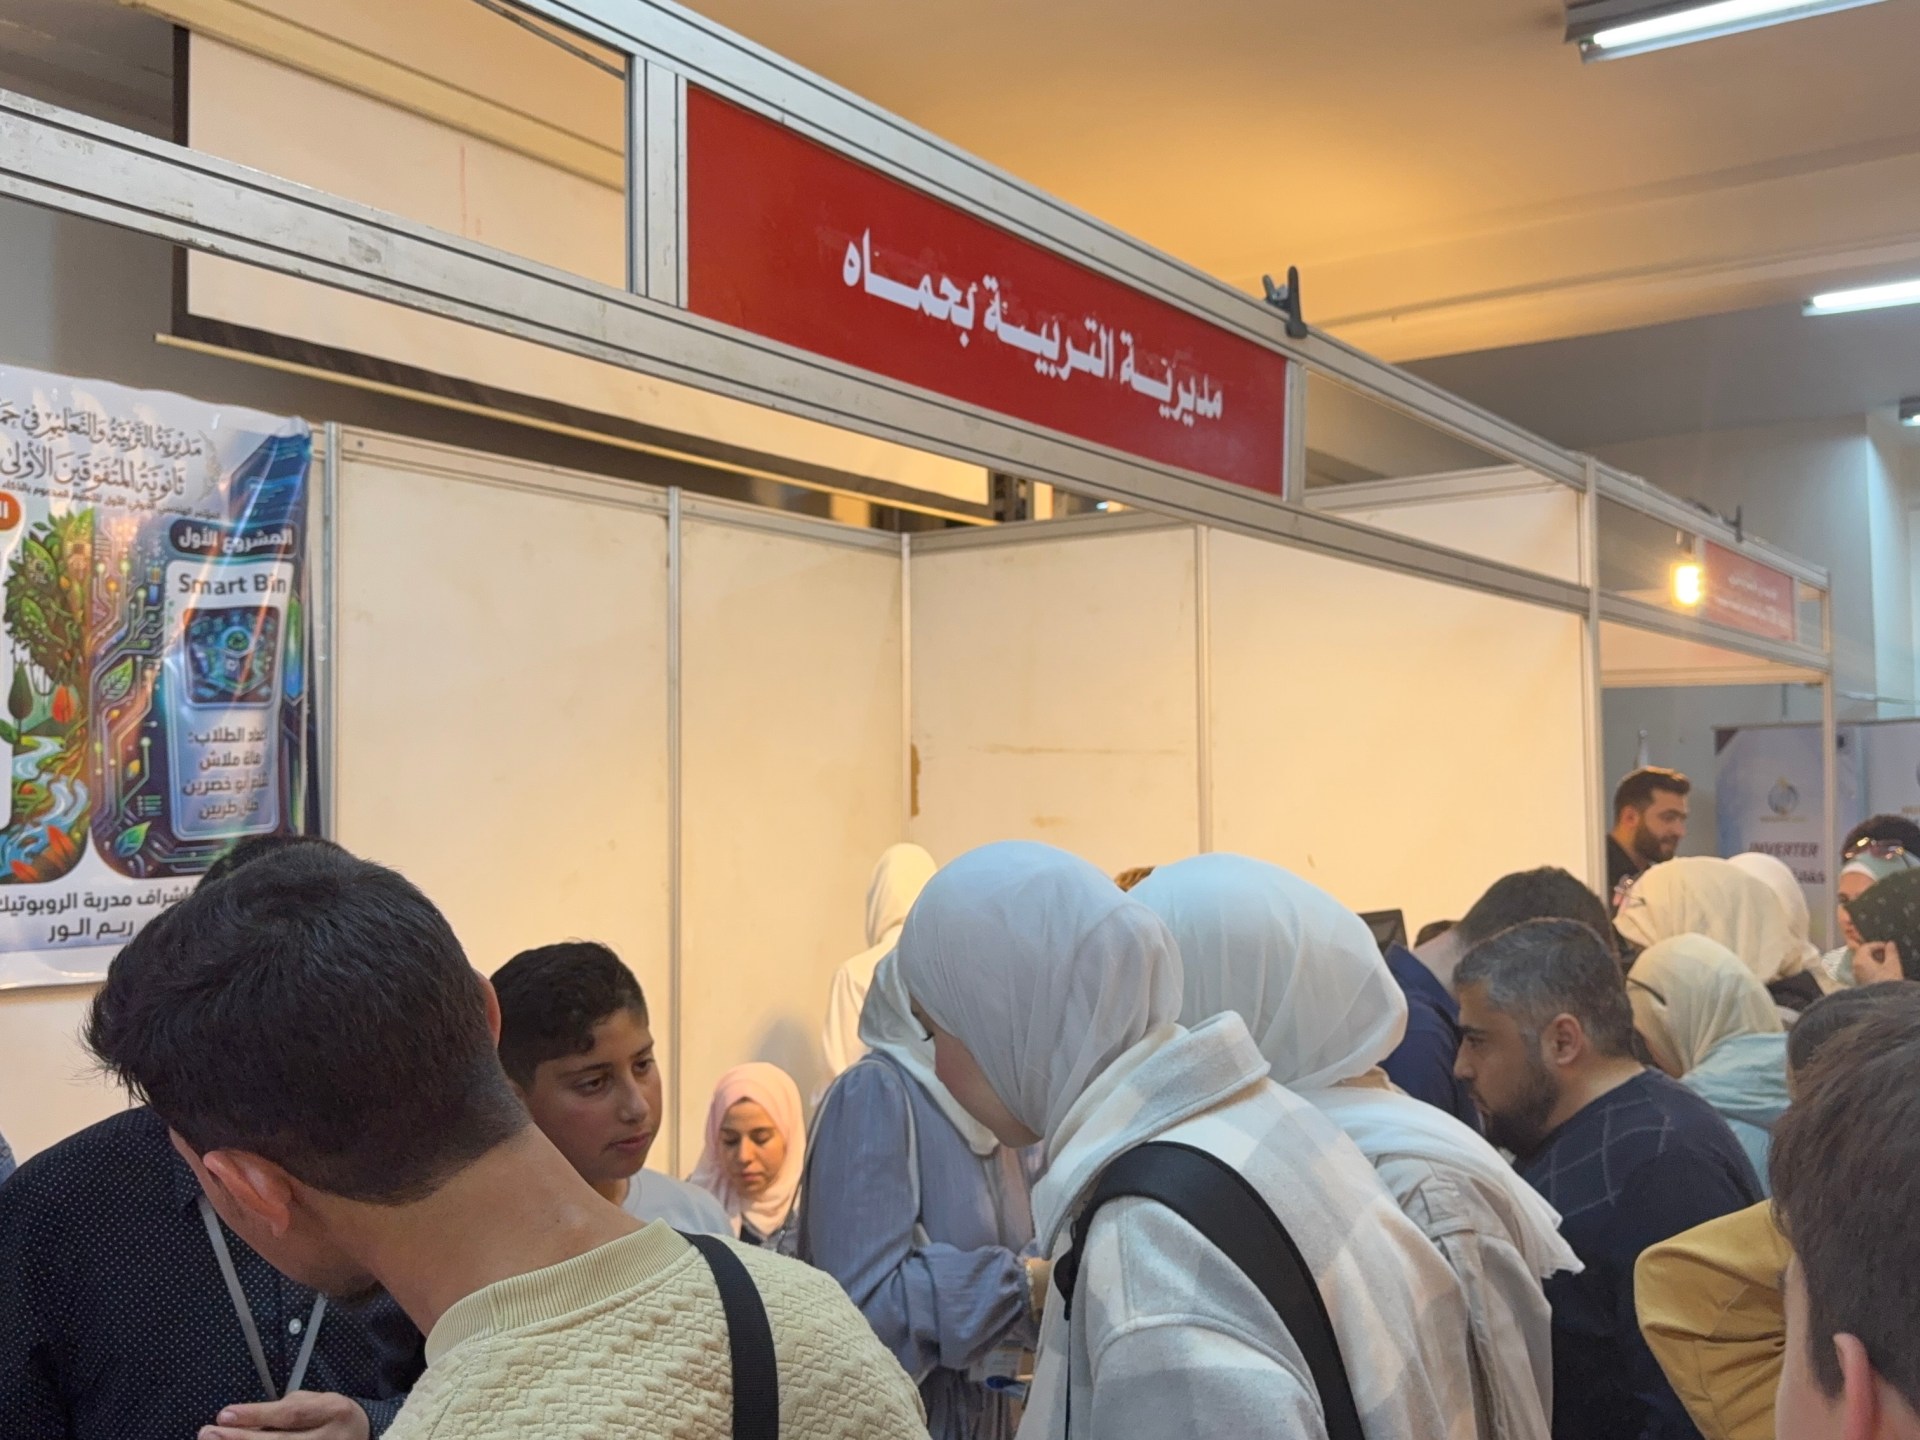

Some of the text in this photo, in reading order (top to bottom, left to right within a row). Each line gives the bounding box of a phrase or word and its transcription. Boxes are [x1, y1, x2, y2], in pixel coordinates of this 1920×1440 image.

[843, 227, 1223, 426] مديرية التربية بحماه
[178, 526, 293, 553] المشروع الأول
[179, 574, 287, 595] Smart Bin
[97, 919, 134, 940] ريم
